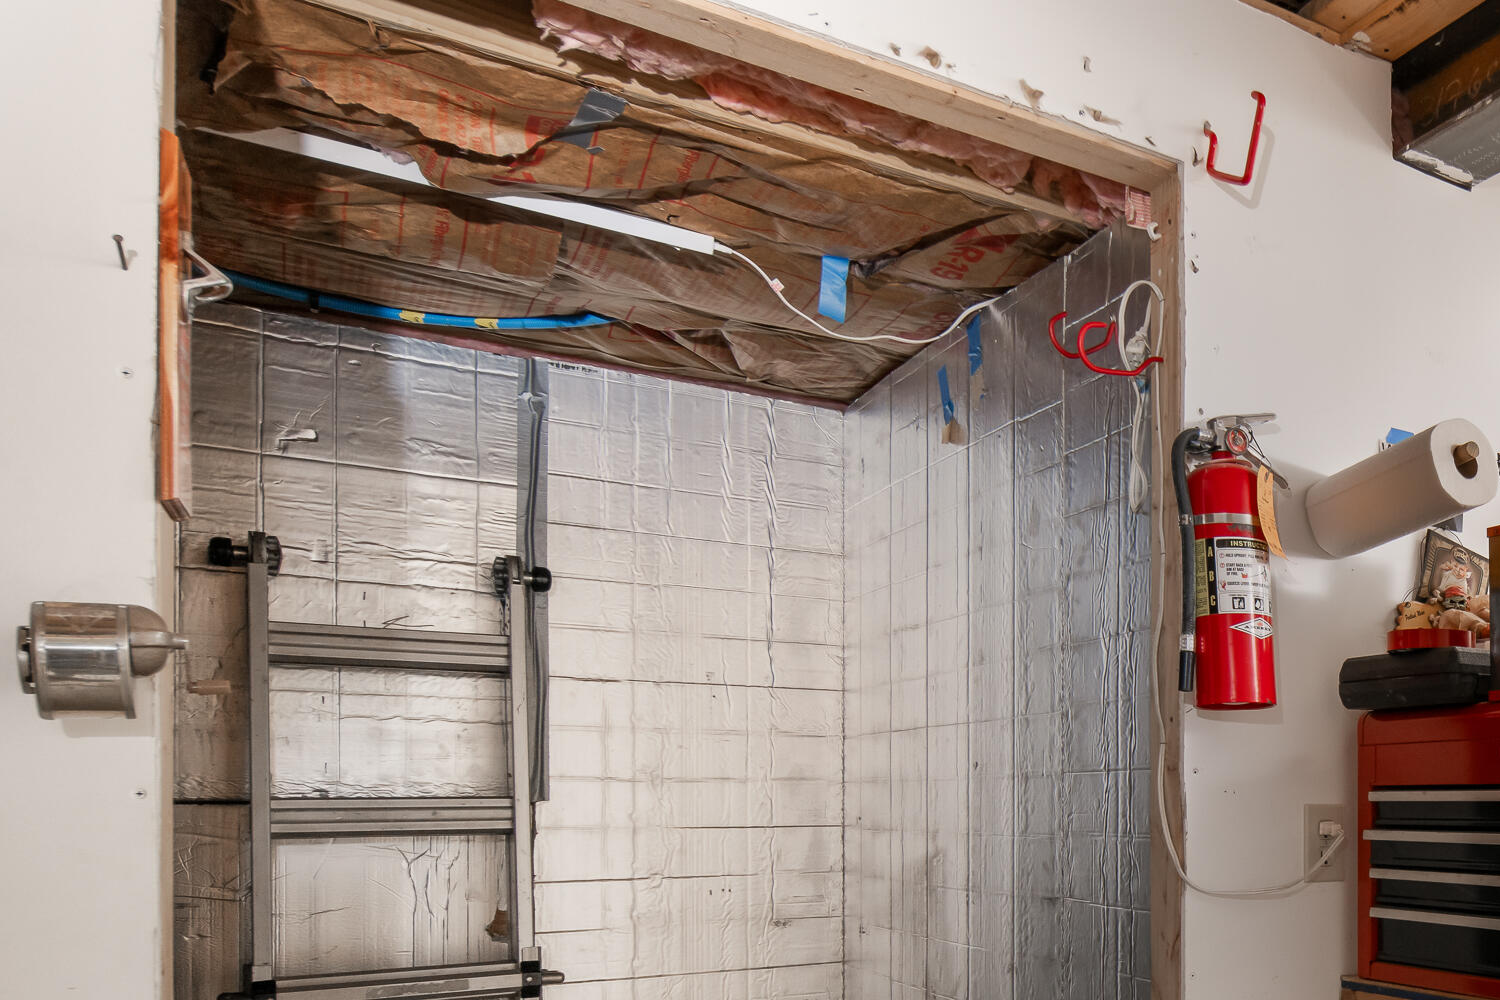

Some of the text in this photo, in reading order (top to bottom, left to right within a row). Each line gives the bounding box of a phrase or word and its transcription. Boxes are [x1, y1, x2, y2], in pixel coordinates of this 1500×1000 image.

[930, 246, 985, 281] R-19
[1208, 546, 1214, 557] A
[1209, 571, 1215, 582] B
[1210, 595, 1216, 606] C
